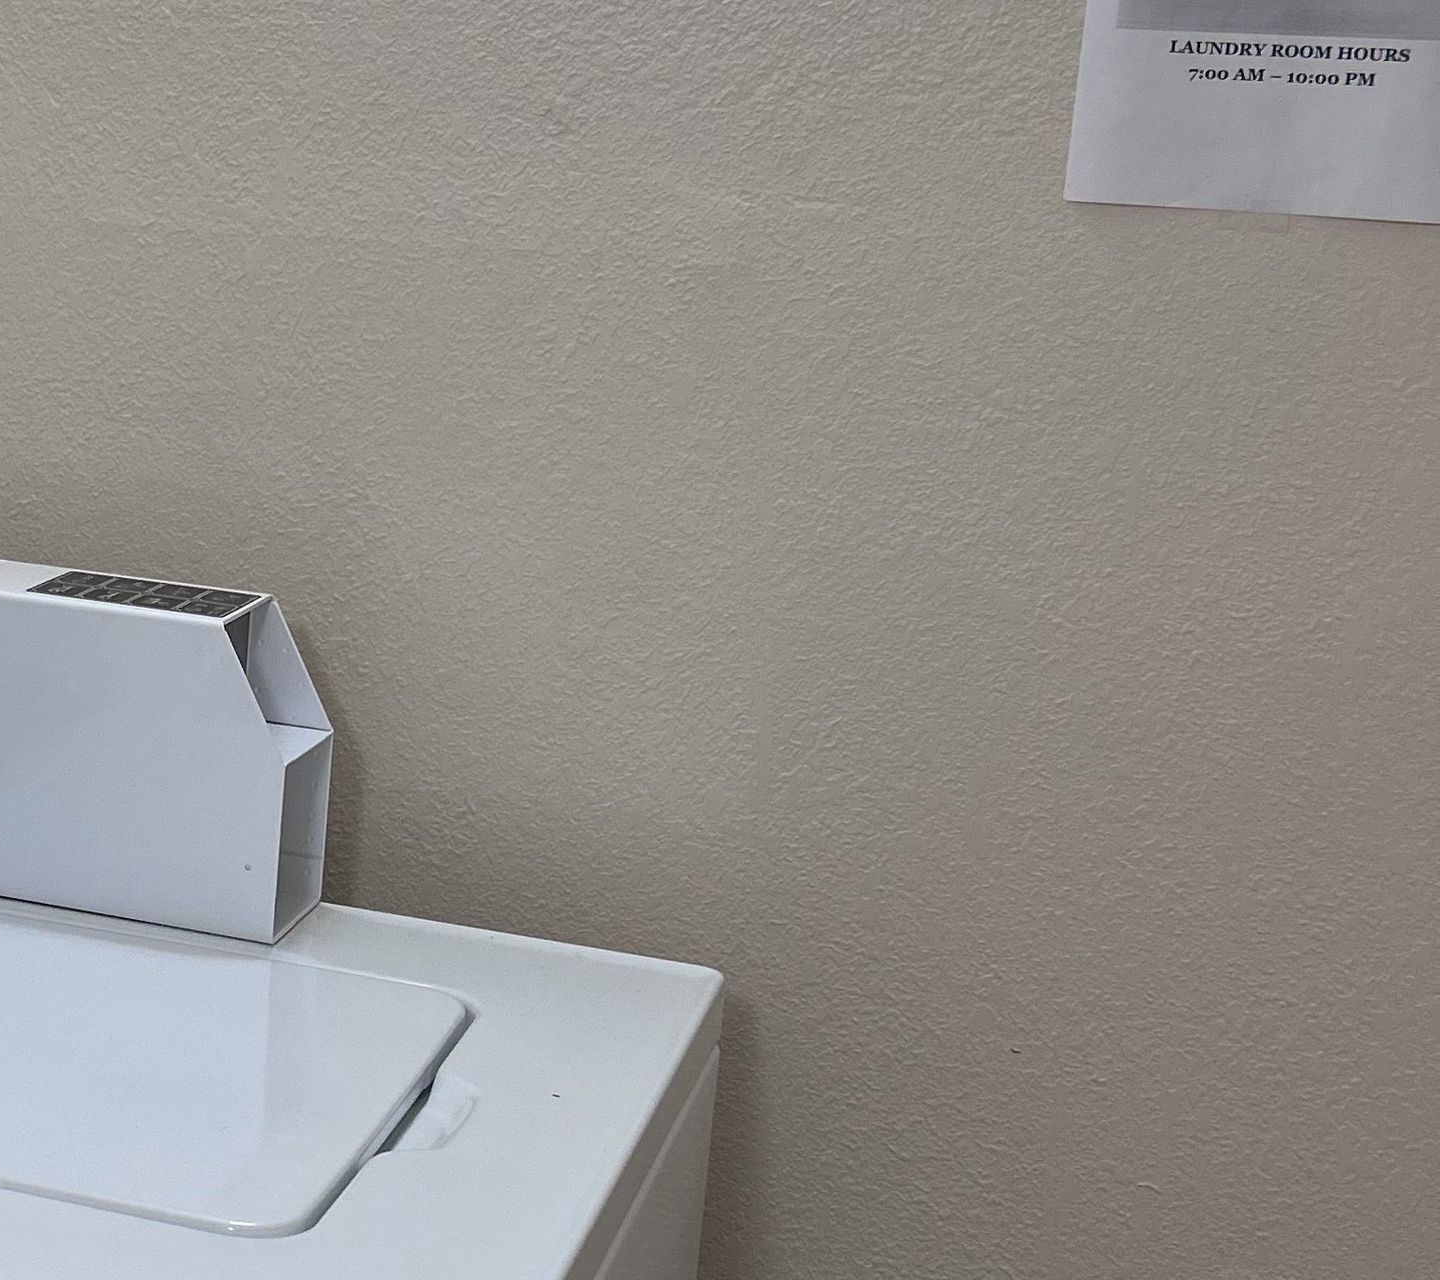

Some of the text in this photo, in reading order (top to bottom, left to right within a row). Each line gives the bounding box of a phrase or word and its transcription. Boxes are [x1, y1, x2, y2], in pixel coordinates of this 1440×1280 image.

[1169, 40, 1411, 63] LAUNDRY ROOM HOURS
[1188, 68, 1229, 81] 7:00
[1232, 69, 1266, 82] AM
[1287, 72, 1339, 85] 10:00
[1345, 73, 1376, 87] PM
